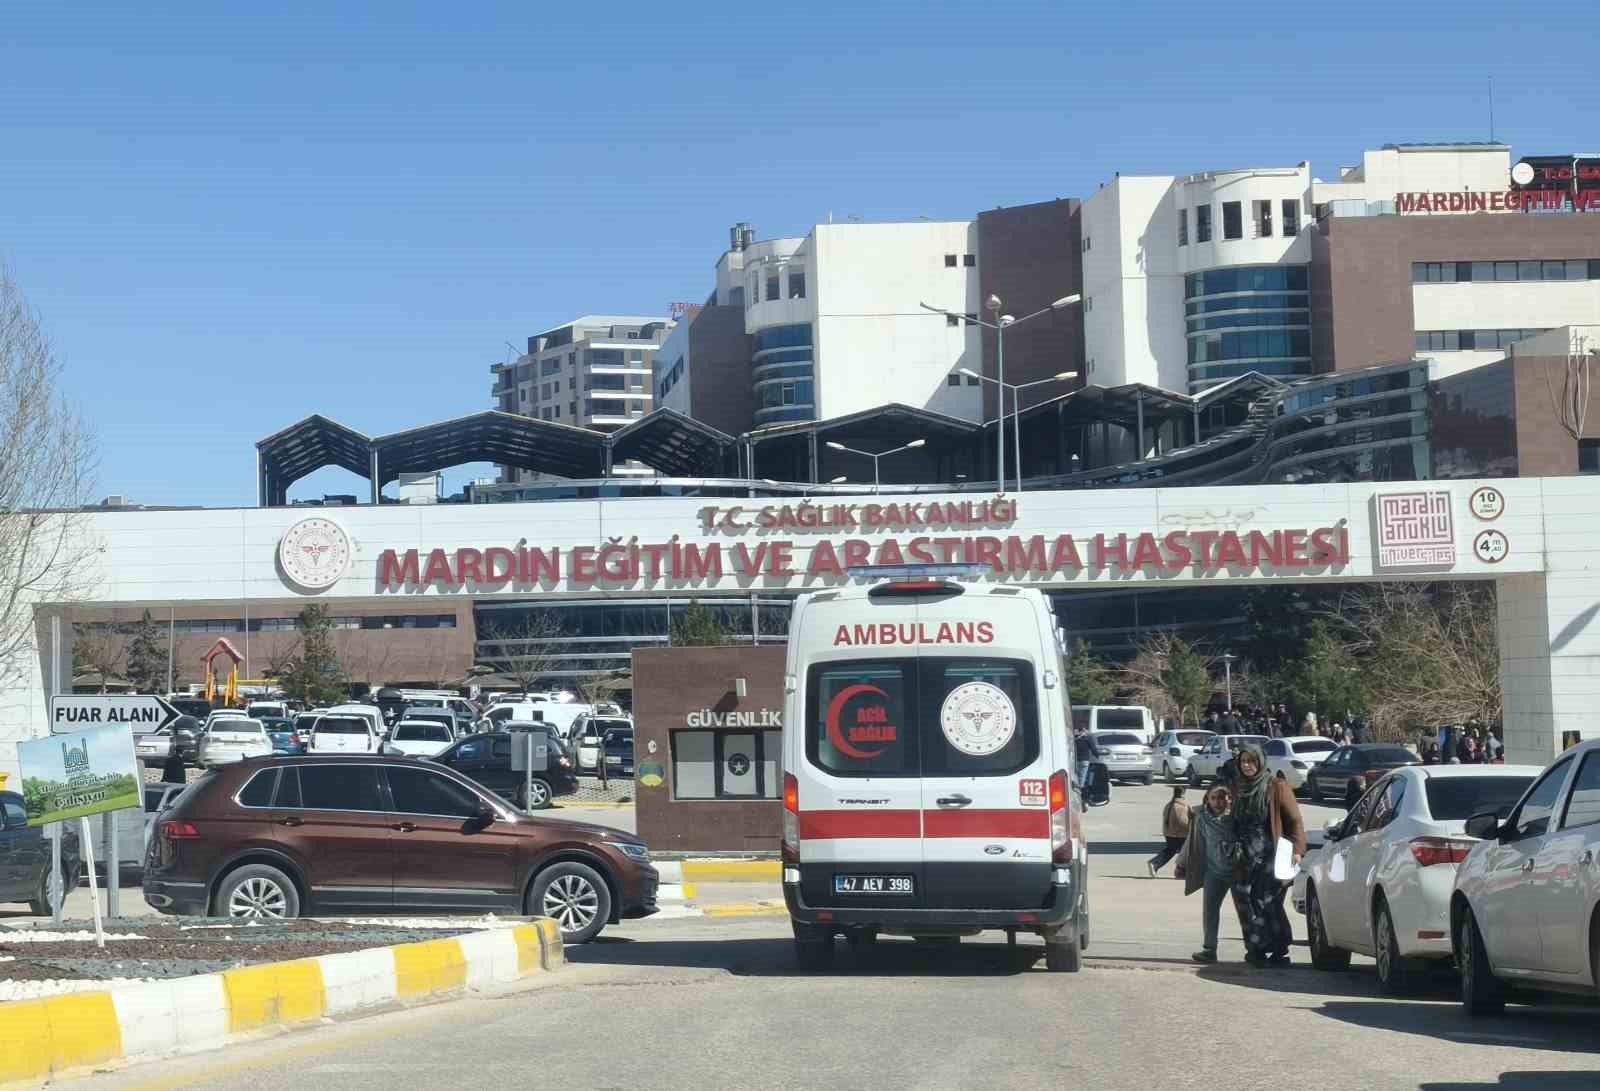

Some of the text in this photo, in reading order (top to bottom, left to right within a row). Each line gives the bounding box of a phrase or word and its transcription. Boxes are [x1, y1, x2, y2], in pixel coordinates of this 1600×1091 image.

[1478, 492, 1496, 503] 10
[703, 492, 1018, 530] T.C. SAĞLIK BAKANLIĞI
[381, 537, 561, 585] MARDİN
[571, 532, 723, 583] EĞİTİM
[735, 541, 795, 579] VE
[1094, 517, 1350, 571] HASTANESİ
[1480, 540, 1490, 551] 4
[833, 621, 995, 647] AMBULANS
[55, 707, 160, 722] FUAR ALANI
[686, 707, 783, 728] GÜVENLİK
[1023, 781, 1044, 795] 112
[844, 878, 911, 891] 47 AEV 398
